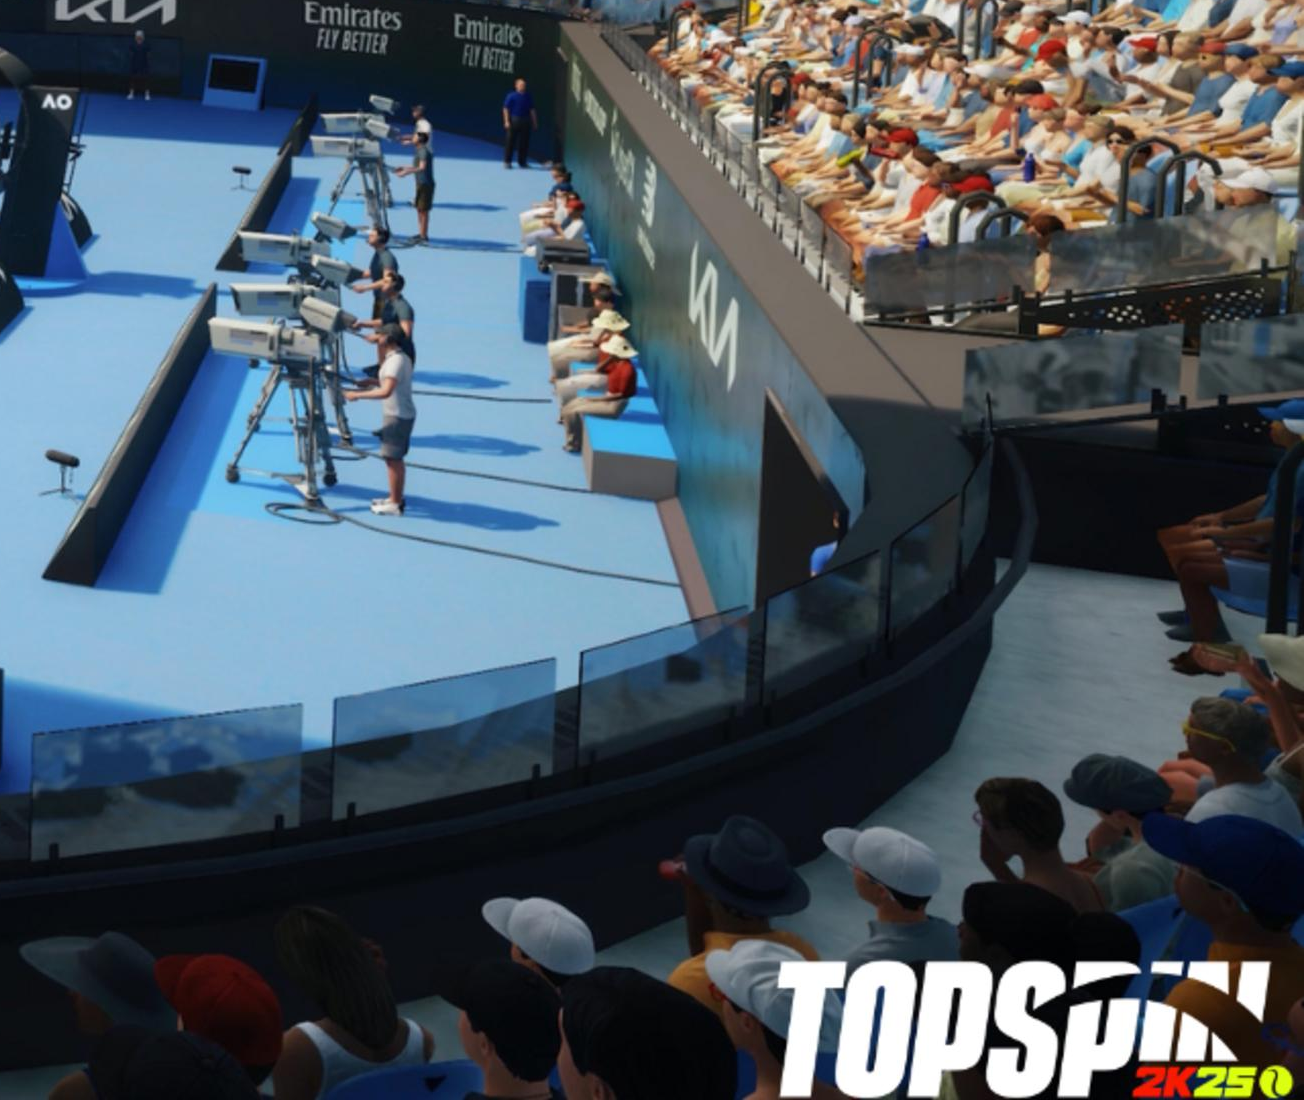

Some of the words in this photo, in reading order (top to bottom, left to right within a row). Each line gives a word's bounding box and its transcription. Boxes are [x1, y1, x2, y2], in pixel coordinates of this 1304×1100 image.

[304, 1, 402, 31] Emirates
[454, 13, 523, 47] Emirates
[316, 28, 339, 50] FLY
[342, 30, 389, 55] BETTER
[462, 44, 480, 66] FLY
[482, 47, 515, 73] BETTER
[42, 94, 72, 110] AO
